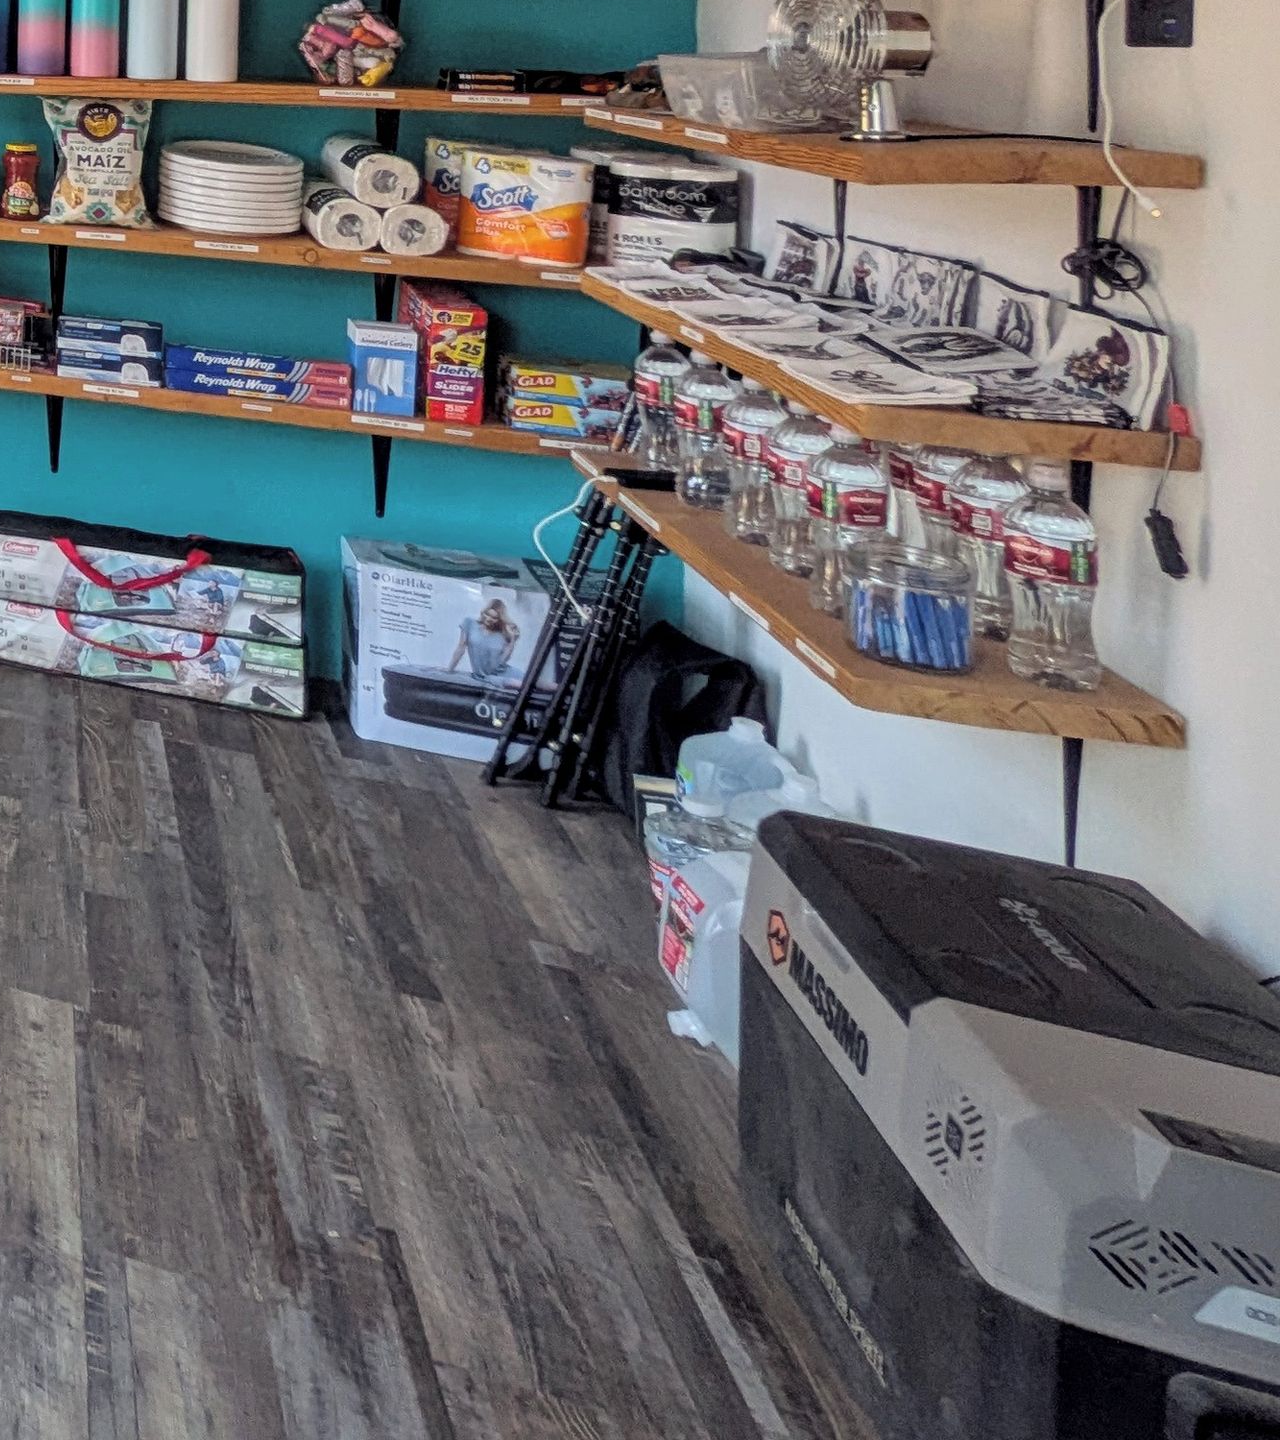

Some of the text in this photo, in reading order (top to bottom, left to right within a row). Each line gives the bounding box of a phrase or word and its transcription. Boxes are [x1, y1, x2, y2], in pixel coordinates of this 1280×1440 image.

[68, 145, 114, 154] AVOCADO
[477, 184, 531, 209] Scott
[475, 216, 527, 233] Comfort
[459, 341, 482, 356] 25
[192, 351, 276, 372] Reynolds Wrap
[439, 364, 477, 378] Hefty
[193, 372, 277, 394] Reynolds Wrap
[434, 381, 475, 393] SLIDER
[517, 374, 556, 388] GLAD
[514, 405, 553, 418] GLAD
[788, 938, 869, 1077] MASSIMO
